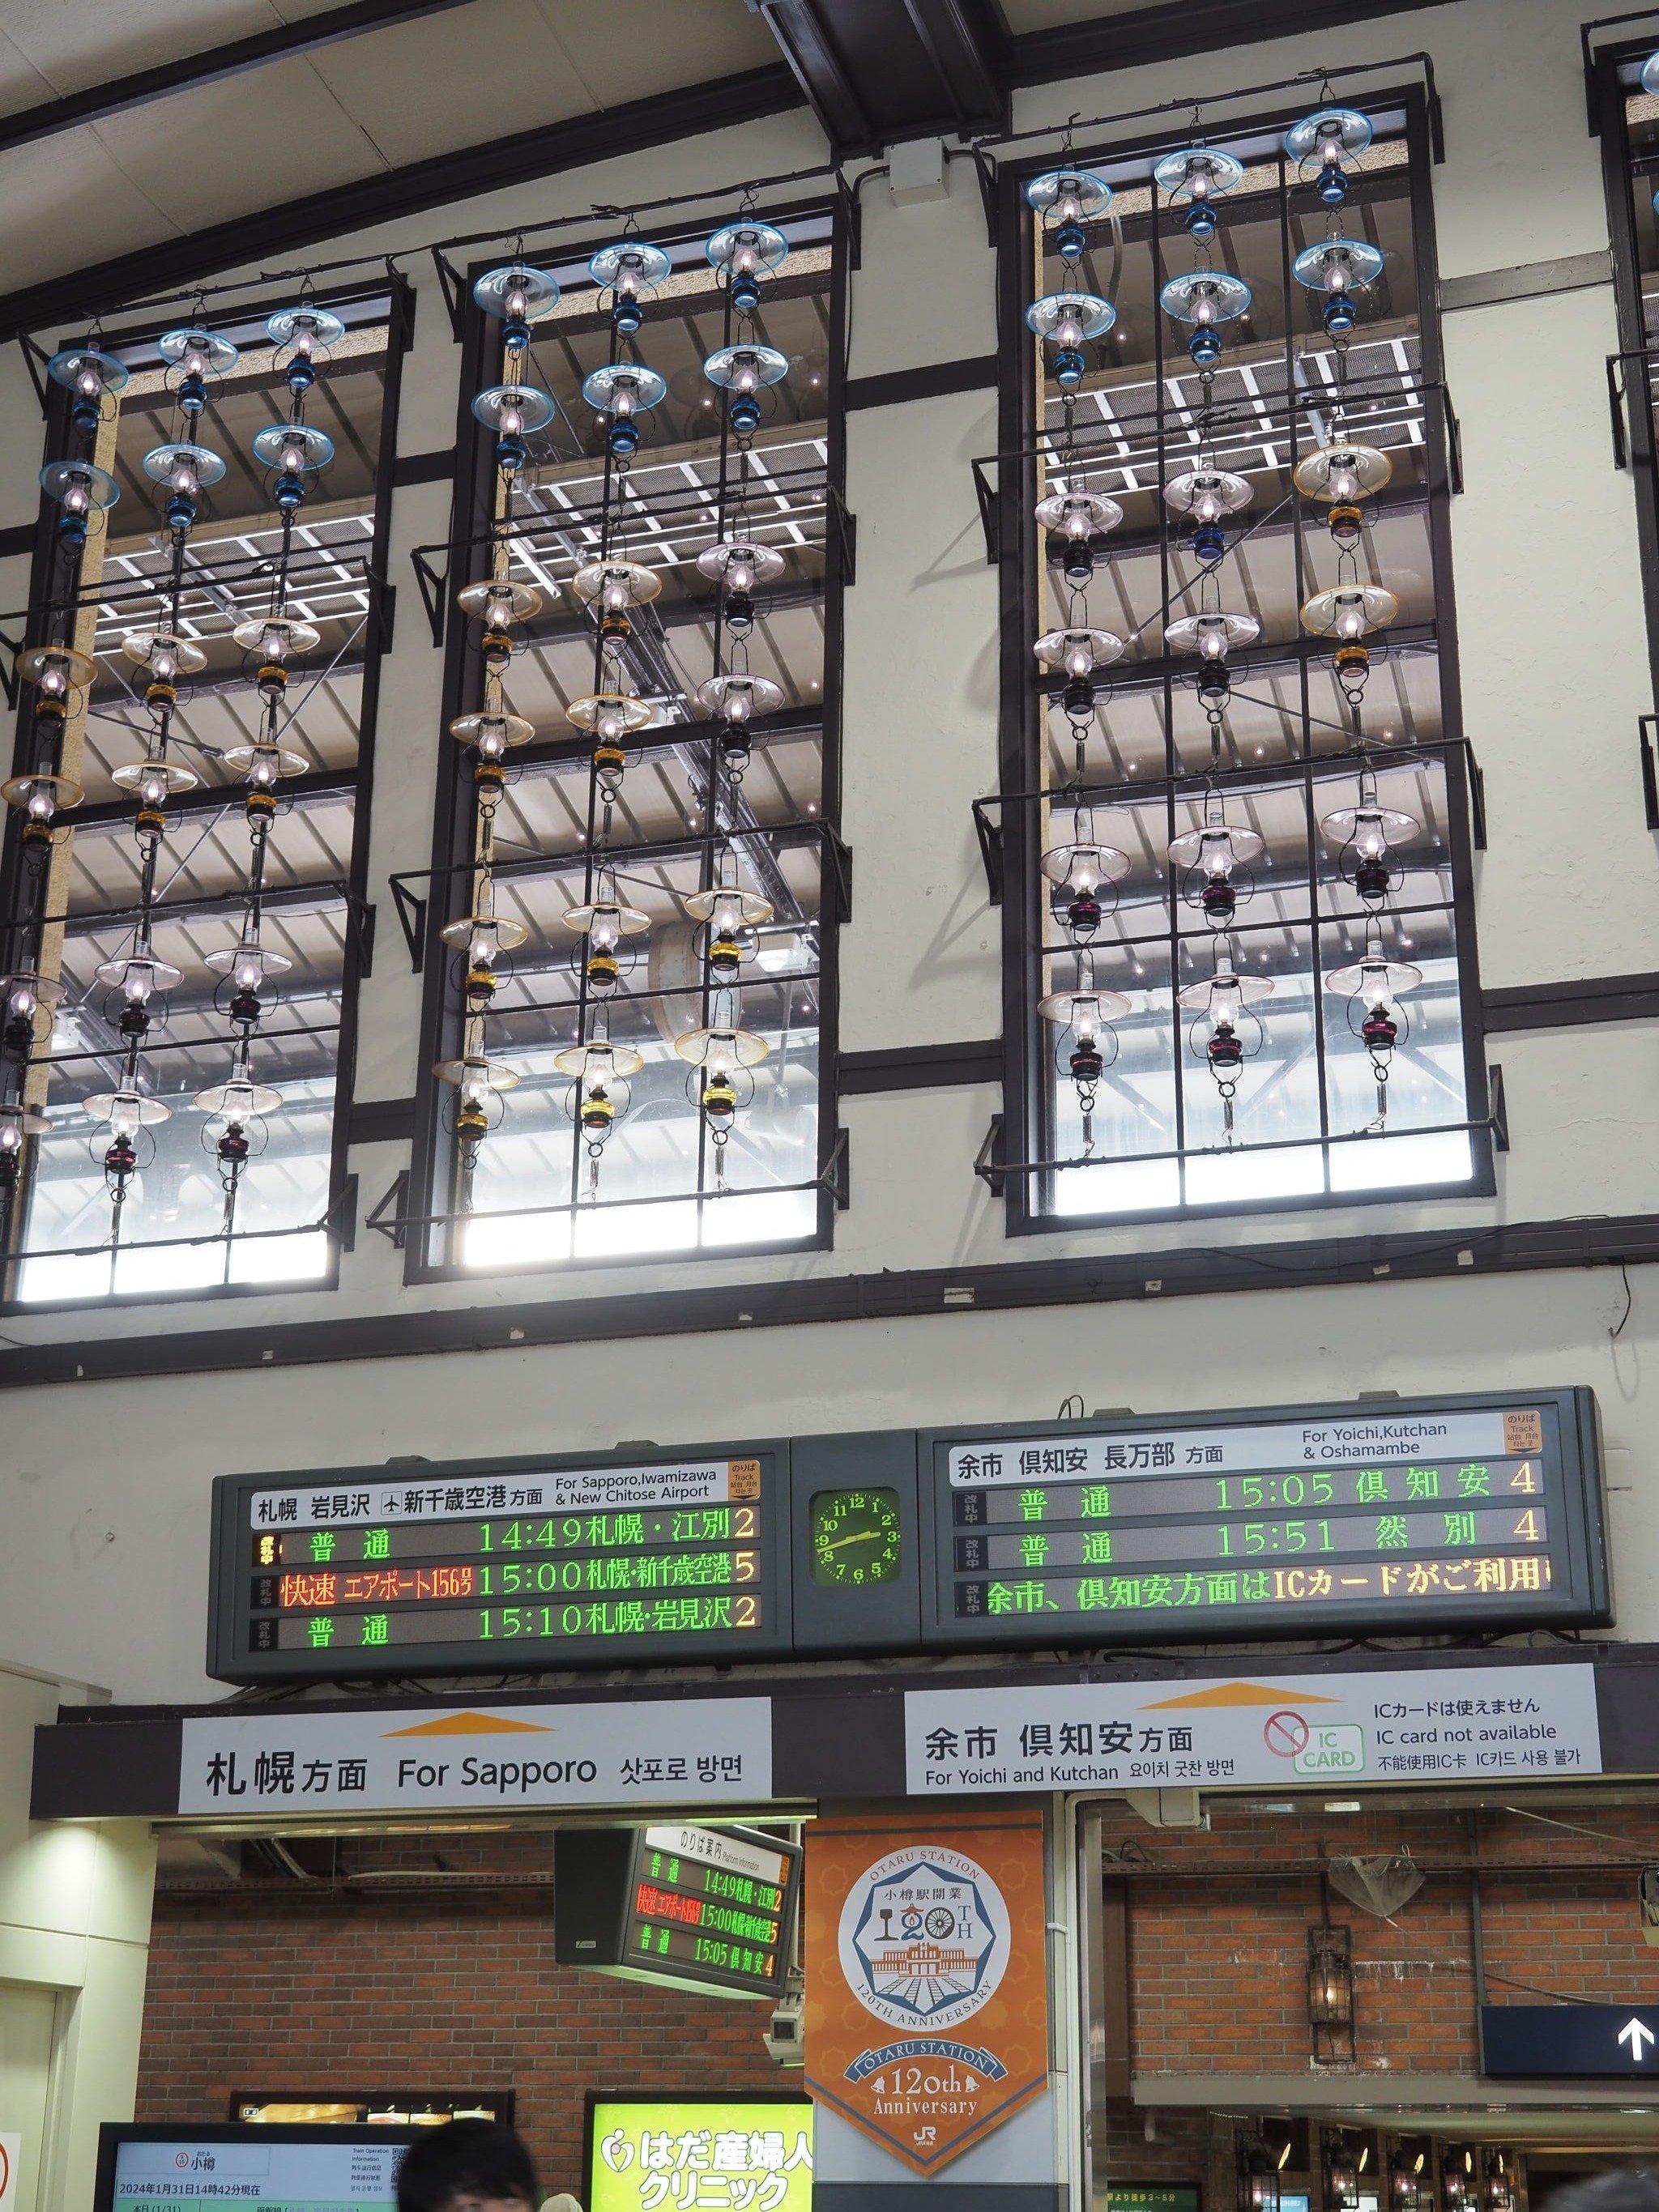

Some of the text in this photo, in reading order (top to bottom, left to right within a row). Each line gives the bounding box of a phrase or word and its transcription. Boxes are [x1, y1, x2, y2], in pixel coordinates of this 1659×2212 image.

[1303, 1423, 1448, 1443] For Yoichi,Kutchan
[1303, 1442, 1420, 1459] & Oshamambe
[957, 1442, 1223, 1480] 余市 倶知安 長万部 方面
[556, 1470, 717, 1491] For Sapporo,Iwamizawa
[1216, 1473, 1333, 1509] 15:05
[1510, 1461, 1536, 1493] 4
[258, 1485, 542, 1523] 札幌 岩見沢 新千歳空港 方面
[556, 1485, 709, 1505] & New Chitose Airport
[849, 1498, 864, 1508] 12
[834, 1505, 847, 1516] 11
[872, 1502, 878, 1513] 1
[480, 1519, 581, 1551] 14:49
[735, 1509, 754, 1537] 2
[823, 1520, 838, 1531] 10
[881, 1515, 891, 1526] 2
[819, 1535, 829, 1545] 9
[887, 1532, 897, 1542] 3
[1218, 1519, 1335, 1555] 15:51
[1514, 1509, 1538, 1541] 4
[824, 1551, 834, 1562] 8
[882, 1548, 893, 1559] 4
[837, 1564, 846, 1575] 7
[853, 1569, 864, 1579] 6
[872, 1562, 881, 1574] 5
[279, 1574, 336, 1607] 快速
[344, 1567, 472, 1600] エアポート156号
[480, 1562, 581, 1594] 15:00
[735, 1552, 754, 1581] 5
[988, 1558, 1550, 1614] 余市、倶知安方面はICカードがご利用
[480, 1605, 581, 1639] 15:10
[736, 1596, 755, 1626] 2
[1374, 1698, 1541, 1719] ICカードは使えません
[925, 1725, 997, 1760] 余市
[1319, 1733, 1337, 1748] IC
[1377, 1725, 1557, 1745] IC card not available
[1303, 1750, 1355, 1768] CARD
[1378, 1748, 1580, 1771] 不能使用IC卡 IC카드 사용 불가
[207, 1751, 742, 1796] 札幌方面 For Sapporo 삿포로 방면
[926, 1758, 1235, 1785] For Yoichi and Kutchan 요이치 굿찬 방면
[870, 1851, 979, 1881] OTARU STATION
[704, 1869, 736, 1898] 14:49
[774, 1890, 782, 1912] 2
[884, 1887, 962, 1901] 小樽駅開業
[700, 1903, 731, 1932] 15:00
[770, 1923, 778, 1943] 5
[695, 1938, 728, 1966] 15:05
[766, 1954, 774, 1976] 4
[857, 1980, 992, 2026] 120TH ANNIVERSARY
[864, 2043, 989, 2070] OTARU STATION
[891, 2065, 962, 2095] 120th
[874, 2098, 977, 2116] Anniversary
[914, 2126, 936, 2140] JR
[190, 2157, 215, 2171] 小樽
[120, 2183, 260, 2196] 2024年1月31日14時42分現在
[639, 2171, 788, 2212] クリニック
